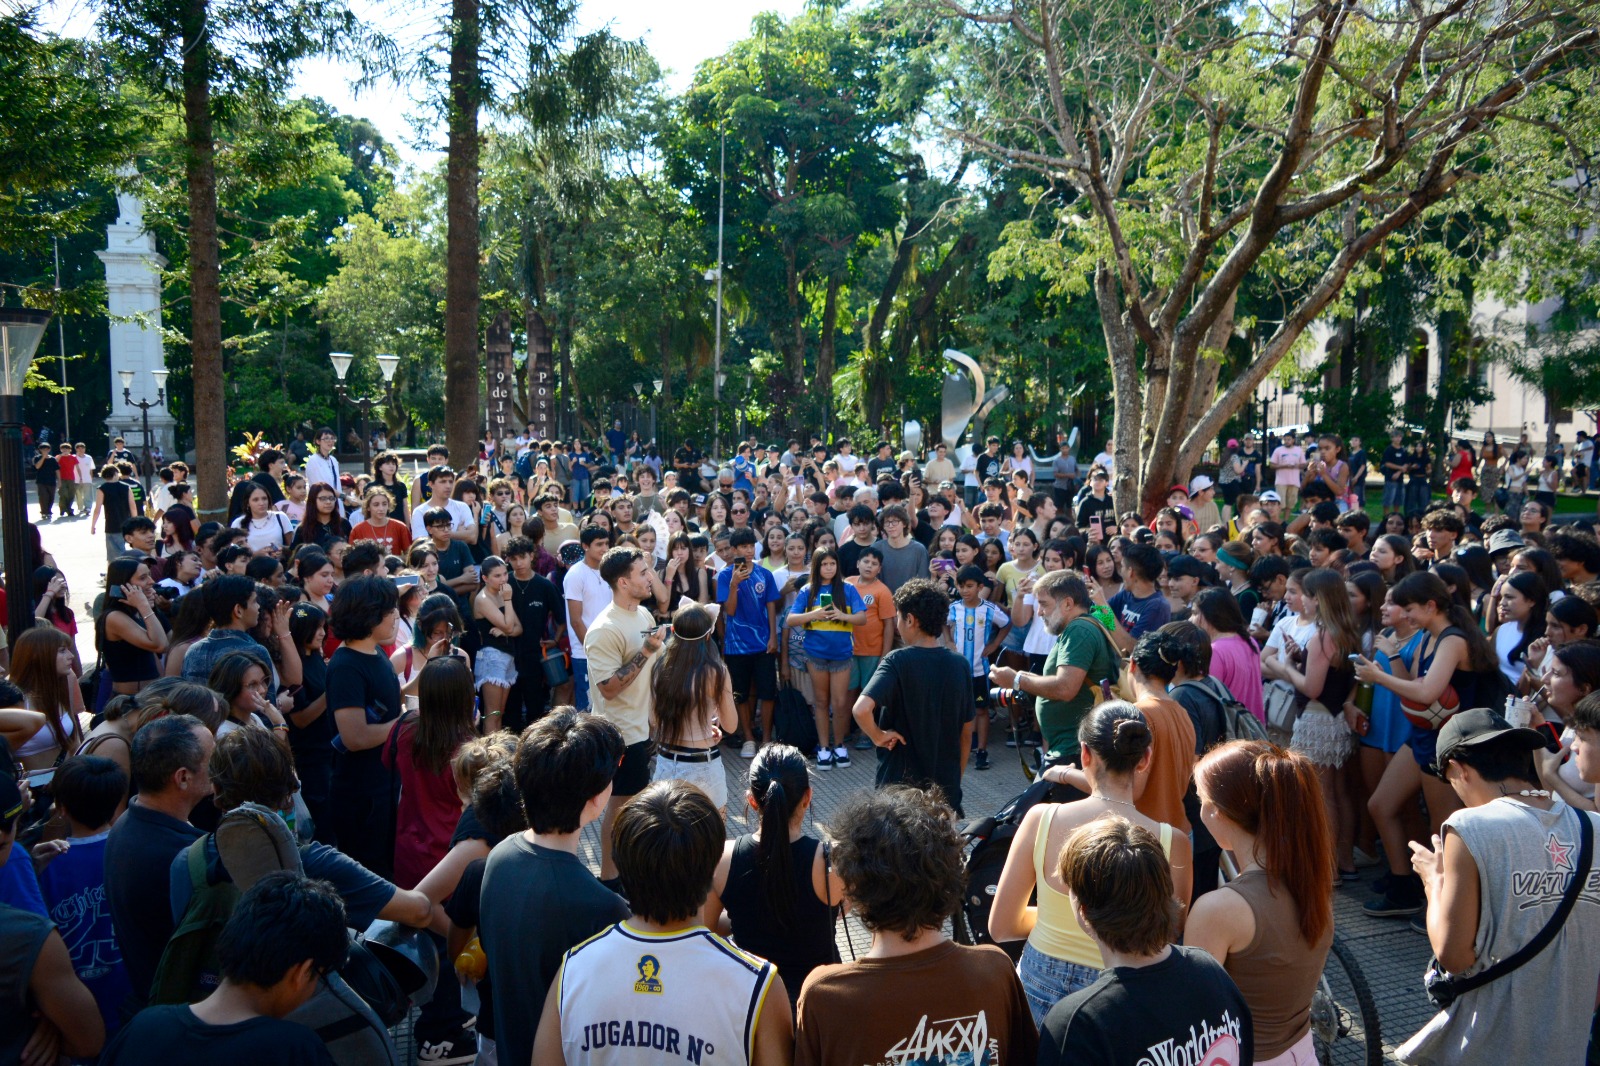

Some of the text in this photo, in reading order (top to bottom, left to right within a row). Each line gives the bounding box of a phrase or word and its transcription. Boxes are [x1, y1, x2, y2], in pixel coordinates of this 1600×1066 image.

[497, 372, 505, 383] 9
[492, 387, 508, 398] de
[963, 627, 974, 641] 10
[635, 983, 649, 992] 1960
[581, 1020, 681, 1055] JUGADOR
